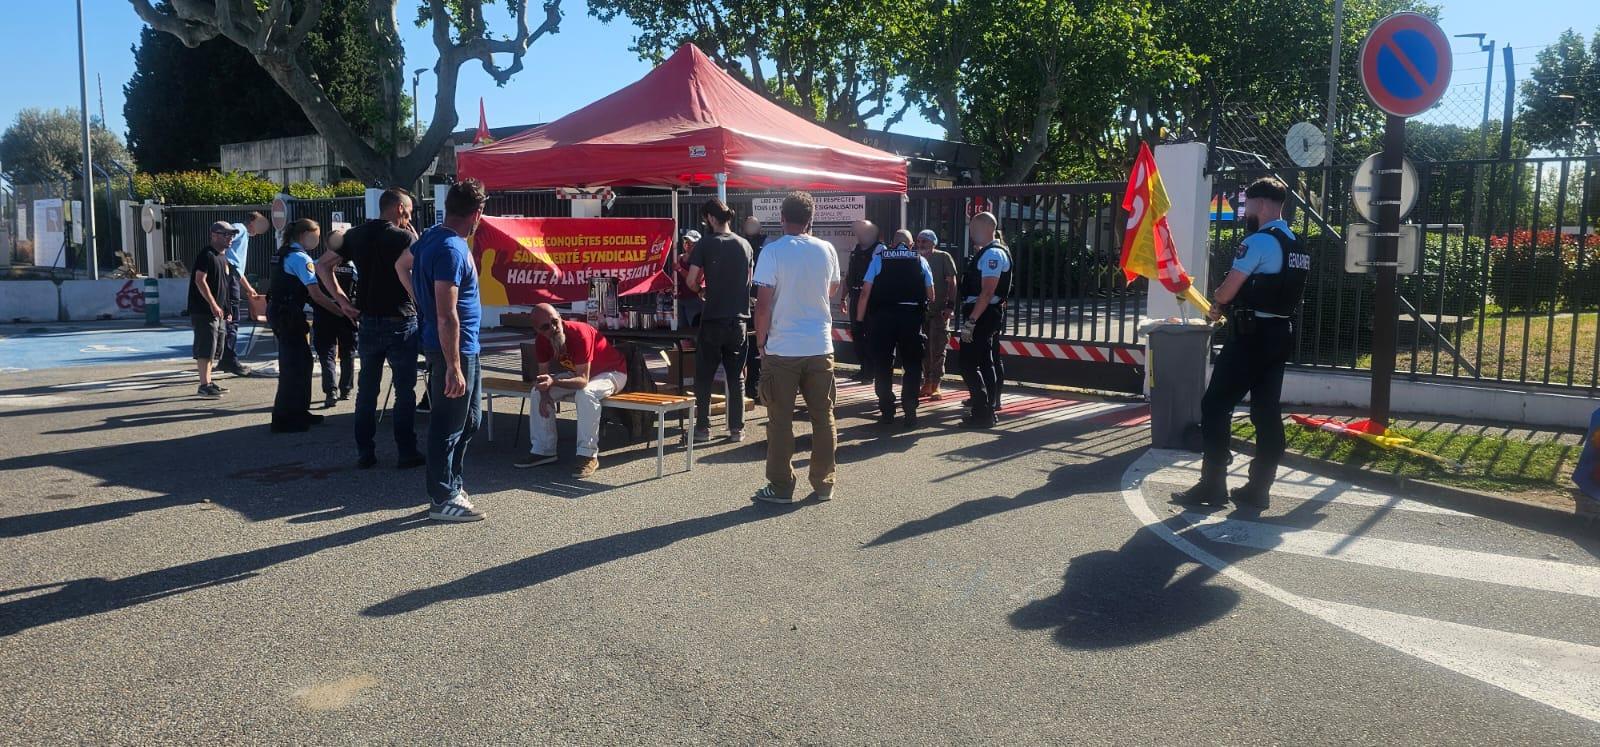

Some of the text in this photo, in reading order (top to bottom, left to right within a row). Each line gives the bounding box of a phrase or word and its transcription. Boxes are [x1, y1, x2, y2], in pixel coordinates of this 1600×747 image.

[545, 234, 601, 248] CONQUÊTES
[602, 235, 647, 246] SOCIALES
[582, 250, 647, 264] SYNDICALE
[507, 268, 549, 285] HALTE
[561, 270, 575, 285] LA
